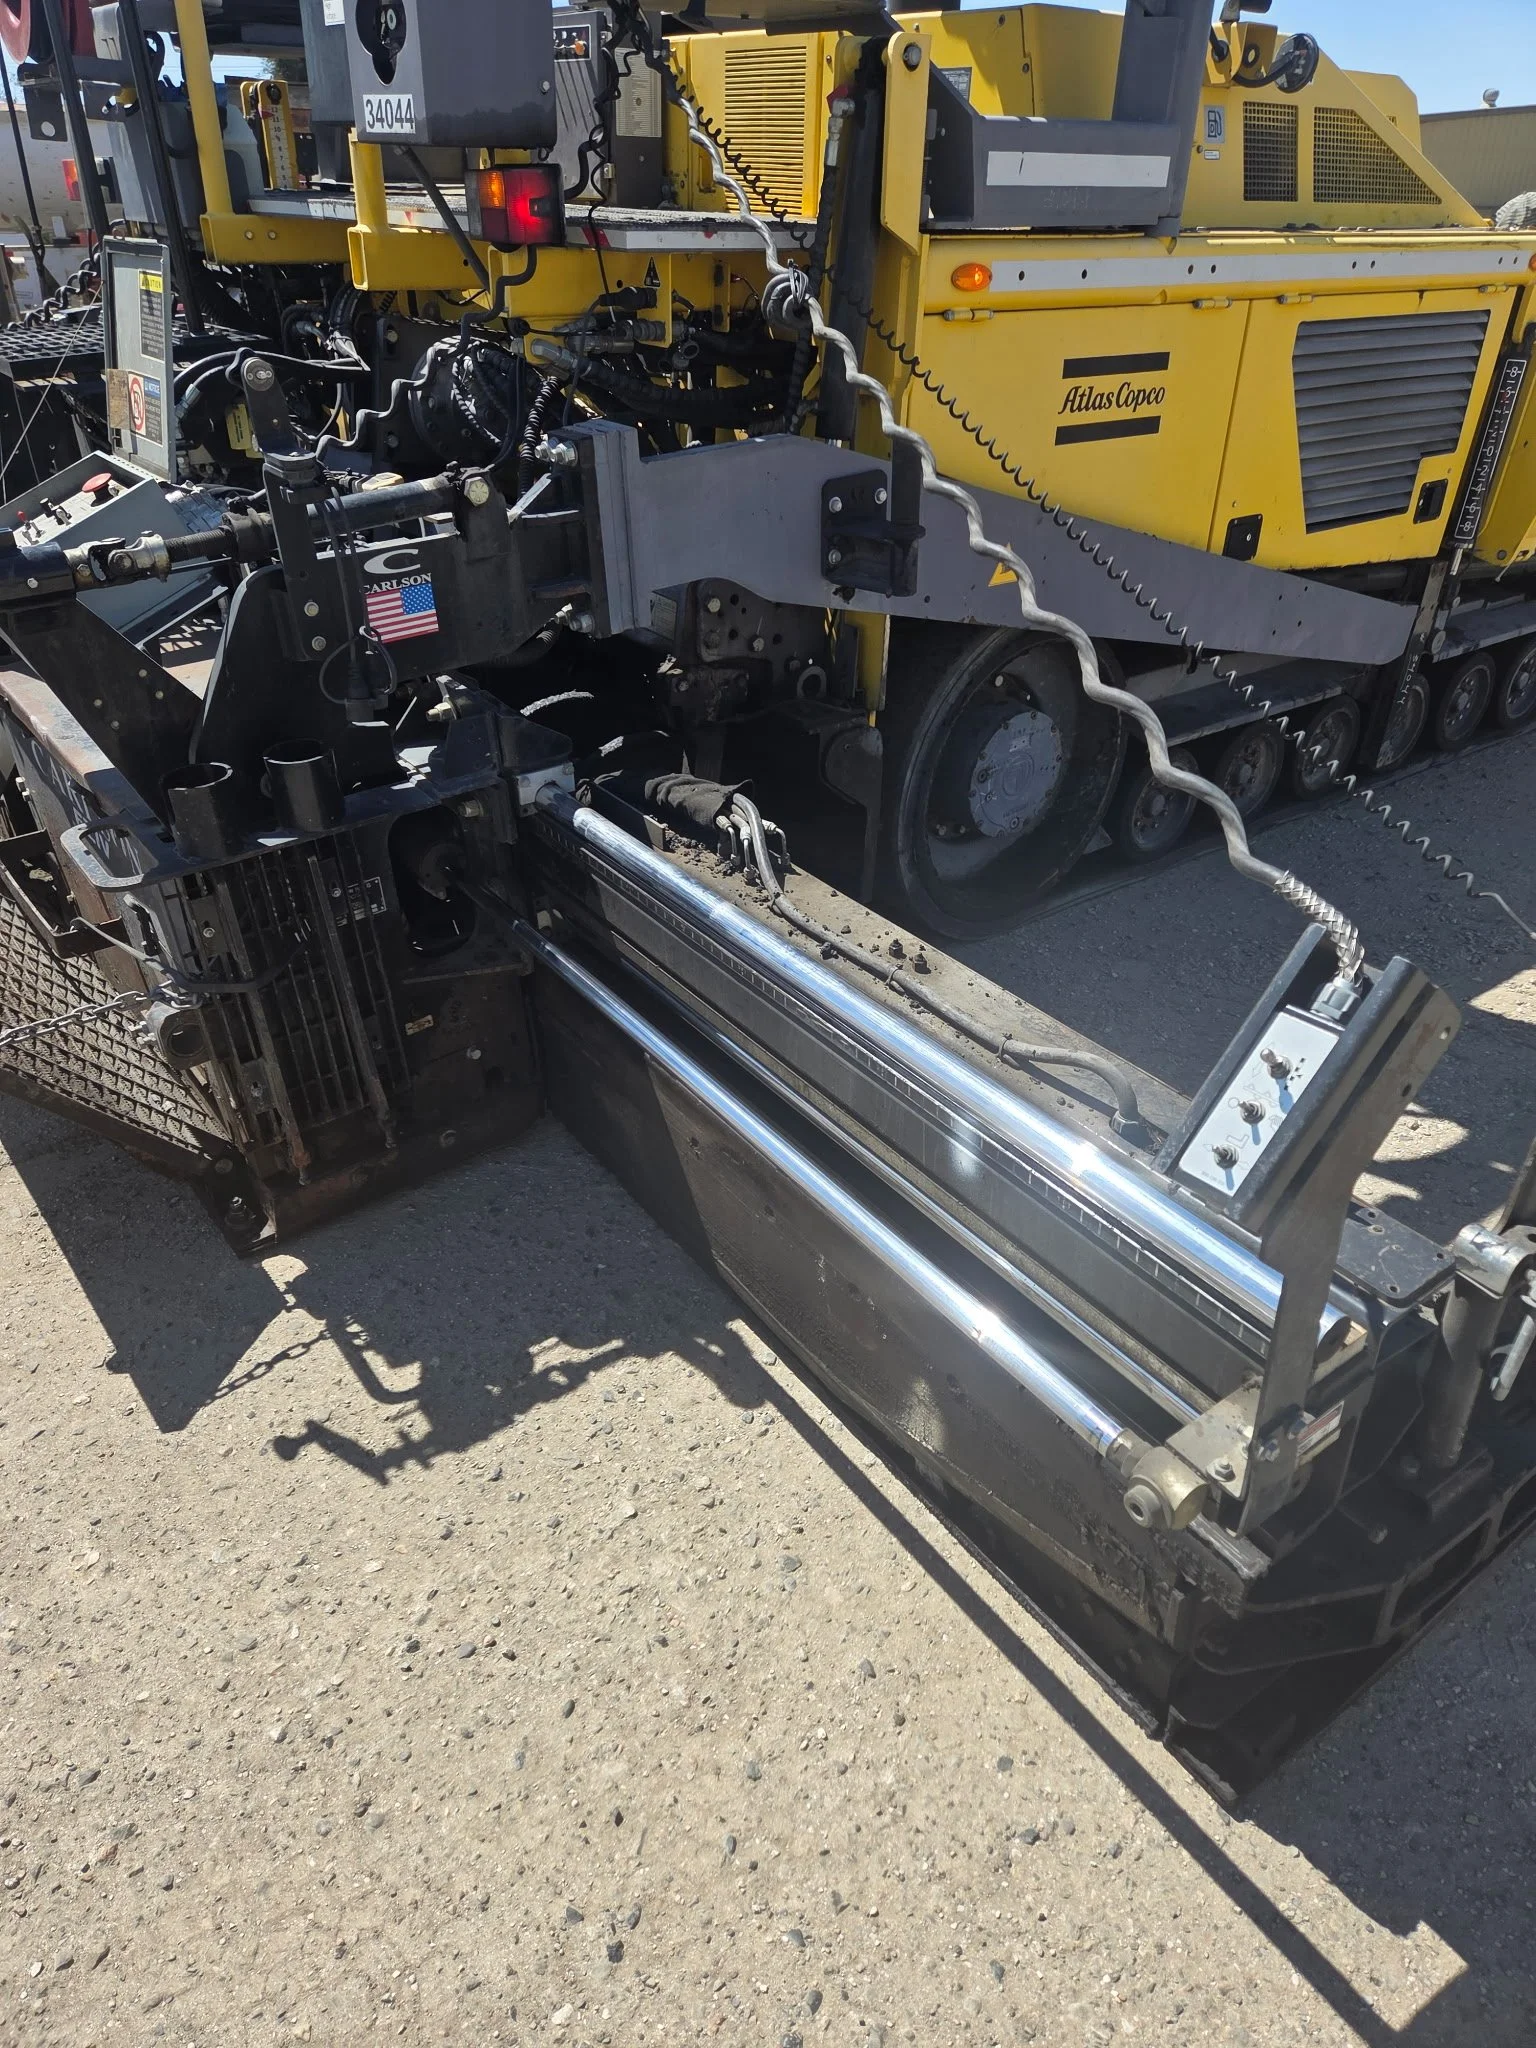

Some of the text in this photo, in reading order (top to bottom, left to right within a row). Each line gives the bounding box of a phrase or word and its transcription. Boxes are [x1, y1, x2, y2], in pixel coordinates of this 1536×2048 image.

[366, 98, 415, 130] 34044
[1057, 381, 1166, 415] Atlas Copco
[361, 572, 432, 594] CARLSON
